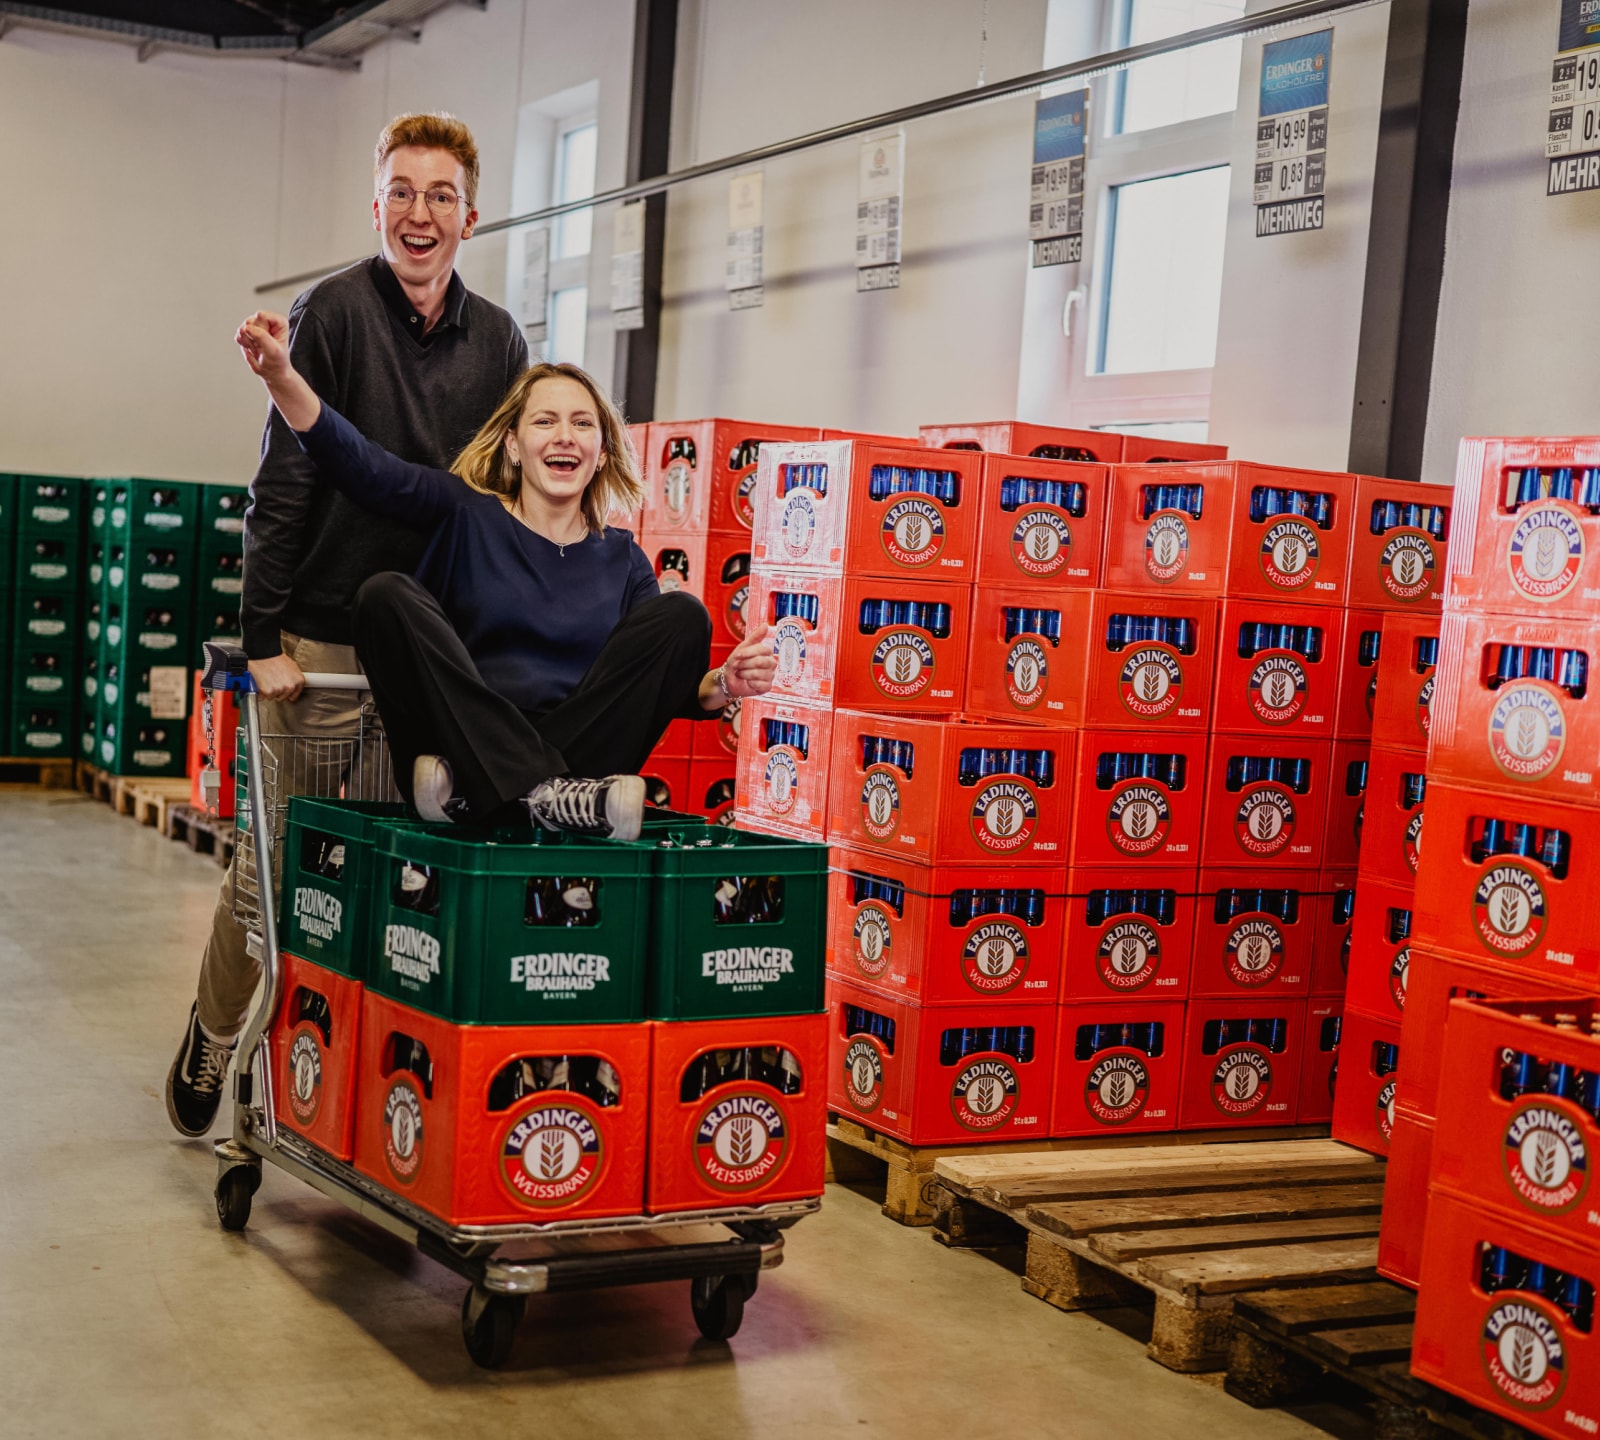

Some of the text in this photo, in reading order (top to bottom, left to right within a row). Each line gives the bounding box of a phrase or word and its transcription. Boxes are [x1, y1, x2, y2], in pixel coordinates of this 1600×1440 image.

[1264, 72, 1324, 91] ALKOHOLFREI
[1266, 58, 1312, 81] ERDINGER
[1276, 119, 1306, 149] 19.99
[1280, 162, 1303, 191] 0.83
[1257, 200, 1322, 235] MEHRWEG
[1034, 237, 1081, 266] MEHRWEG
[885, 501, 942, 530] ERDINGER
[1016, 512, 1069, 541] ERDINGER
[1146, 516, 1188, 544] ERDINGER
[1516, 510, 1581, 548] ERDINGER
[1264, 522, 1317, 552] ERDINGER
[1383, 536, 1434, 564] ERDINGER
[875, 633, 932, 662] ERDINGER
[1008, 642, 1046, 671] ERDINGER
[1124, 650, 1180, 679] ERDINGER
[1253, 658, 1305, 686] ERDINGER
[1496, 690, 1560, 730] ERDINGER
[862, 773, 898, 806] ERDINGER
[976, 784, 1034, 814] ERDINGER
[1112, 788, 1168, 816] ERDINGER
[1240, 791, 1292, 818] ERDINGER
[1478, 868, 1543, 910] ERDINGER
[294, 887, 342, 933] ERDINGER
[300, 914, 333, 941] BRAUHAUS
[855, 909, 890, 941] ERDINGER
[966, 924, 1025, 953] ERDINGER
[1101, 924, 1157, 951] ERDINGER
[1228, 922, 1281, 949] ERDINGER
[384, 924, 440, 975] ERDINGER
[702, 947, 794, 977] ERDINGER
[391, 952, 431, 984] BRAUHAUS
[510, 953, 610, 982] ERDINGER
[715, 968, 781, 985] BRAUHAUS
[525, 975, 596, 991] BRAUHAUS
[543, 992, 577, 1000] BAYERN
[732, 984, 763, 993] BAYERN
[292, 1036, 320, 1076] ERDINGER
[846, 1041, 882, 1076] ERDINGER
[1216, 1052, 1269, 1078] ERDINGER
[956, 1062, 1014, 1091] ERDINGER
[1091, 1057, 1146, 1086] ERDINGER
[386, 1086, 422, 1128] ERDINGER
[700, 1097, 782, 1138] ERDINGER
[508, 1109, 597, 1150] ERDINGER
[1508, 1109, 1585, 1163] ERDINGER
[1486, 1304, 1561, 1360] ERDINGER
